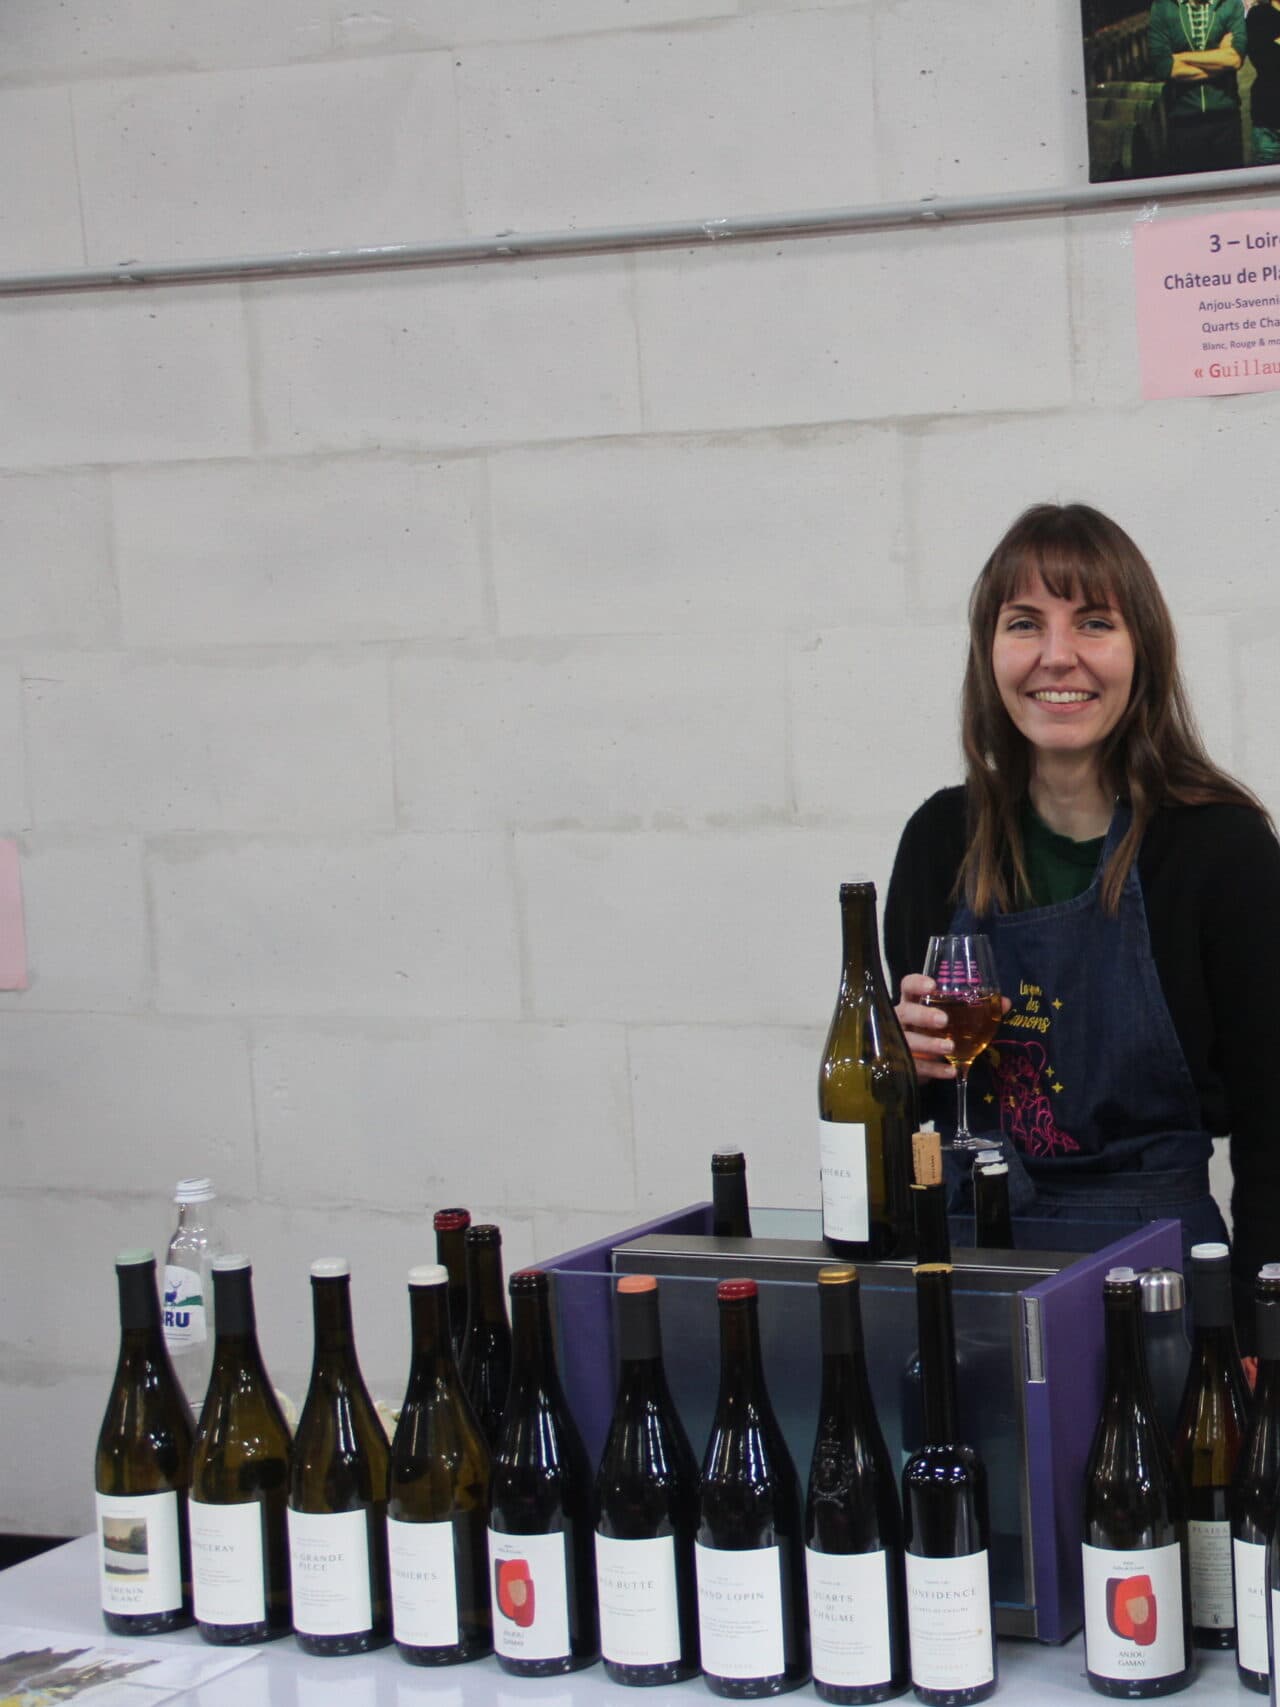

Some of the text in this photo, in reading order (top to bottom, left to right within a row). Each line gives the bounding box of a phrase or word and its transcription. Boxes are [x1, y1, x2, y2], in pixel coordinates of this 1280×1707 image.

[1208, 234, 1222, 253] 3
[1163, 272, 1232, 291] Château
[1236, 267, 1257, 284] de
[1201, 321, 1240, 334] Quarts
[1242, 319, 1257, 330] de
[1230, 339, 1257, 350] Rouge
[1258, 337, 1266, 347] &
[163, 1311, 190, 1328] RU
